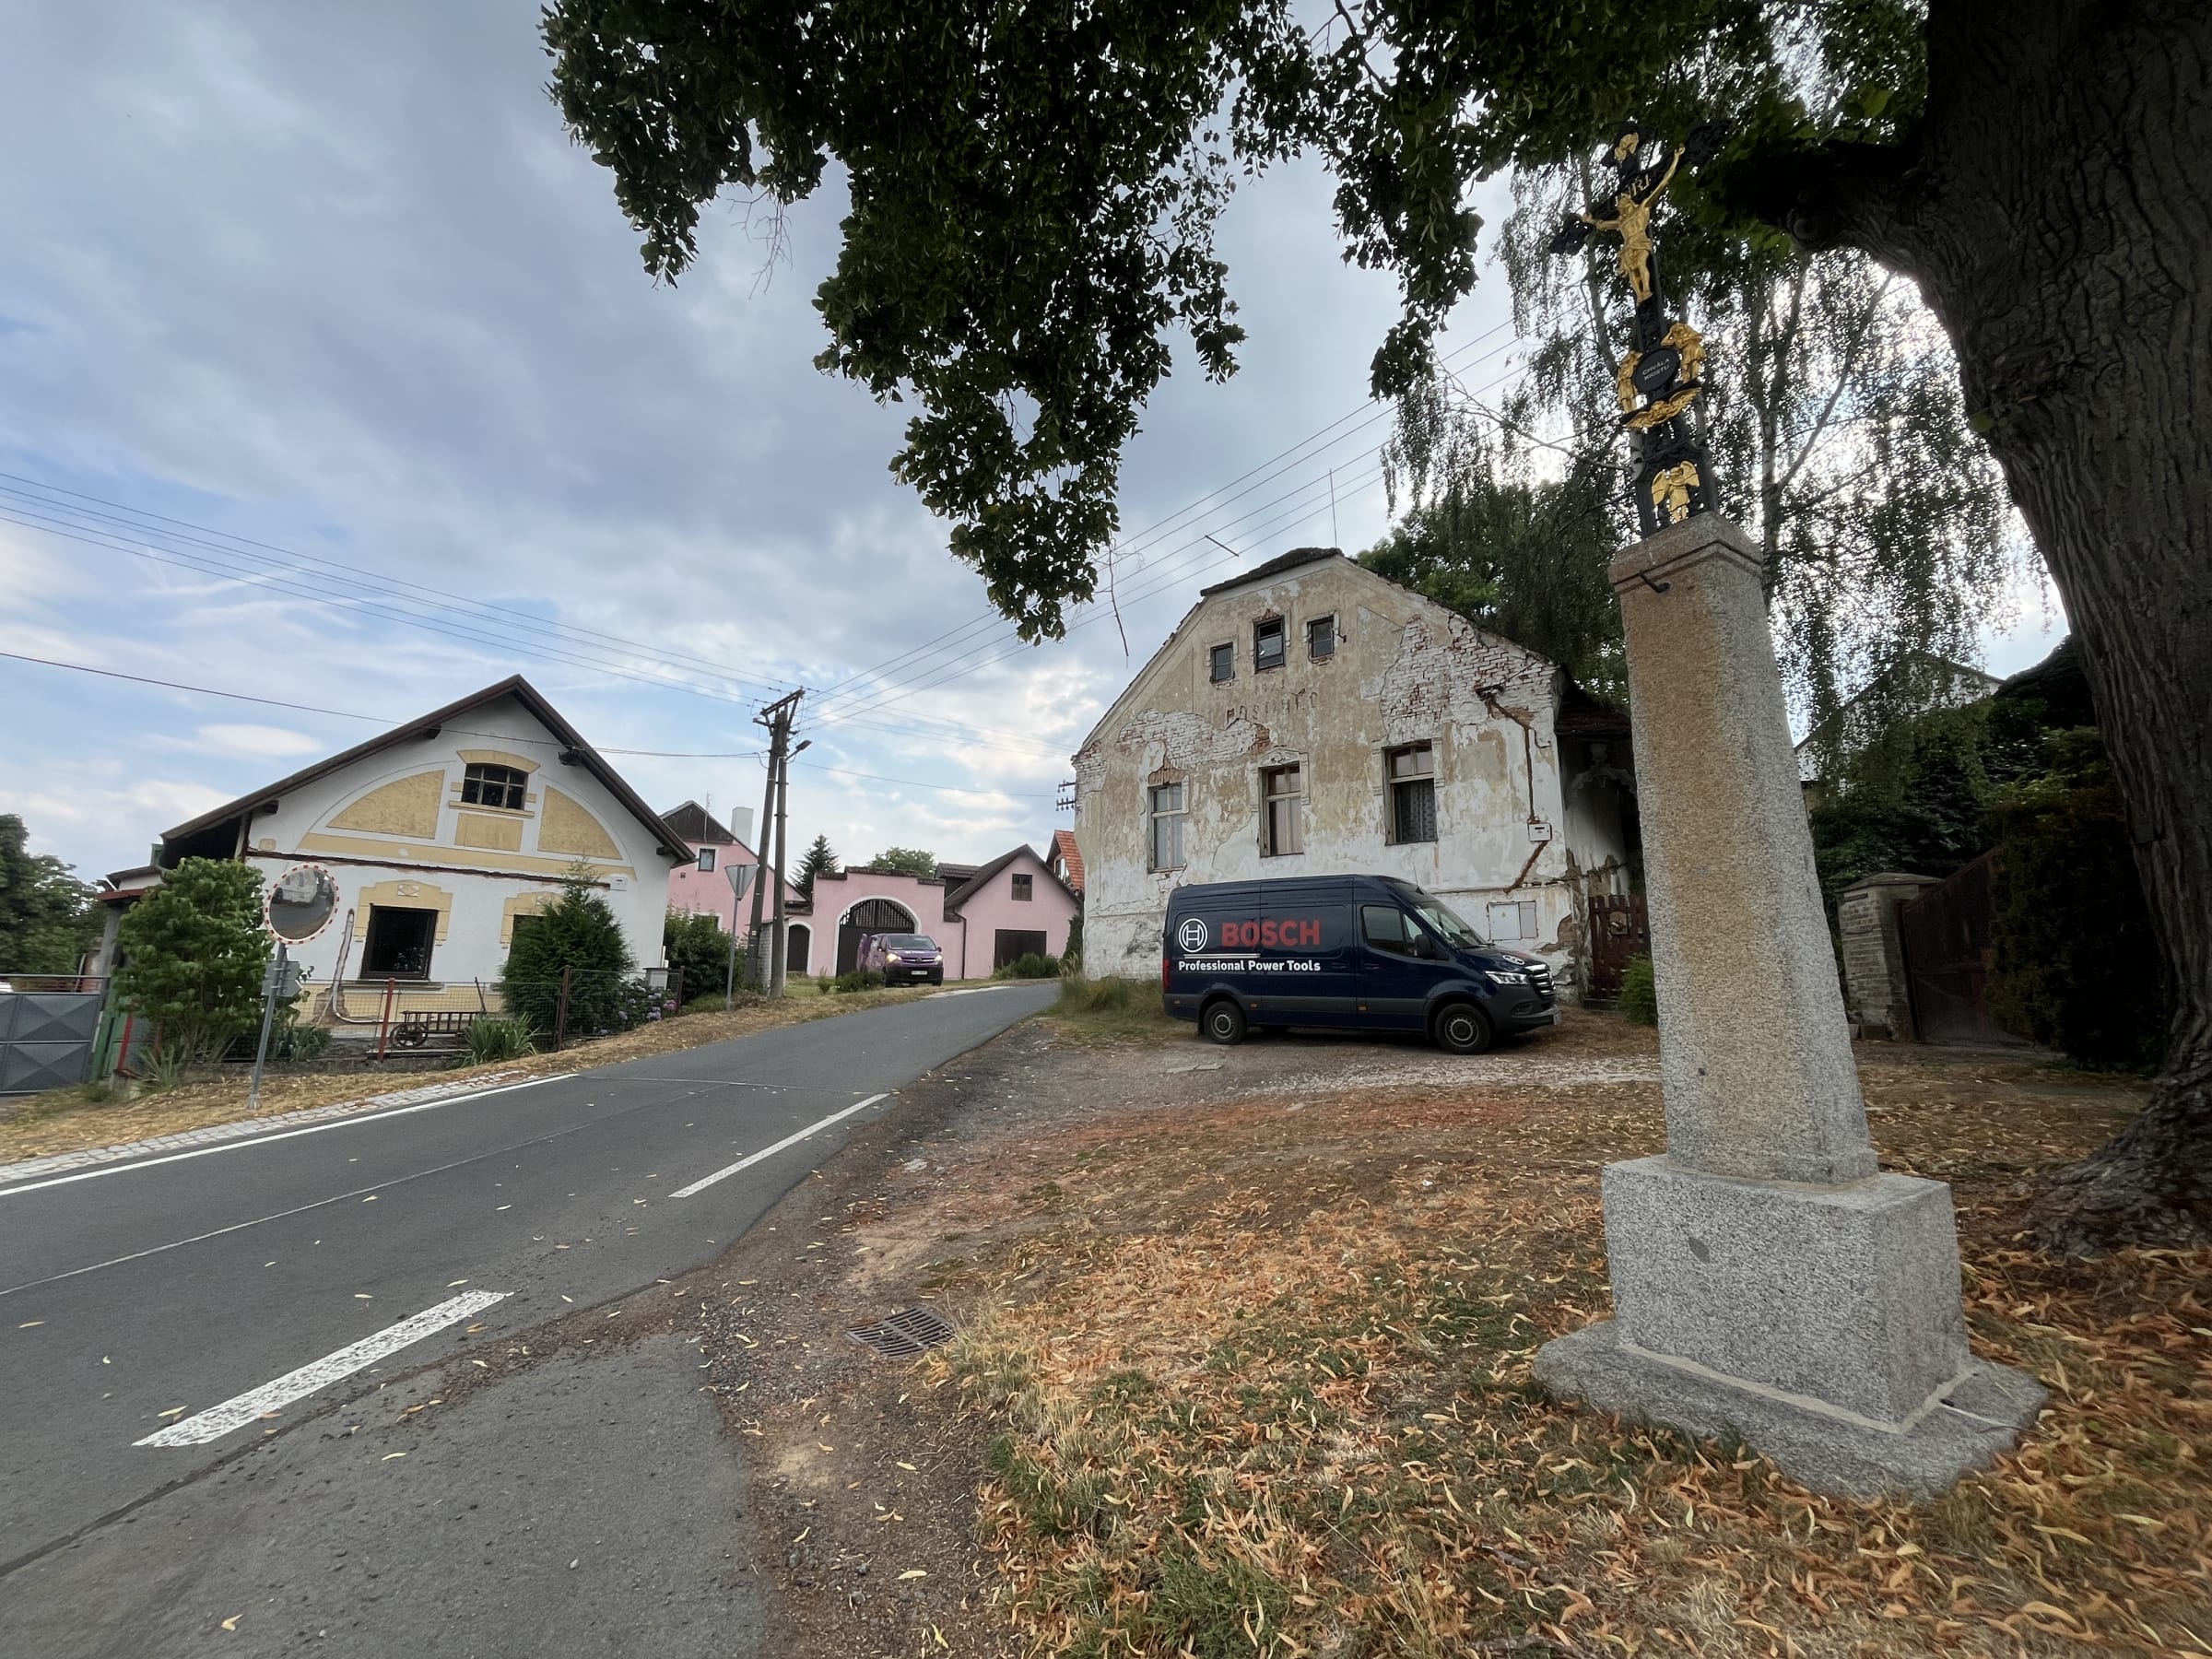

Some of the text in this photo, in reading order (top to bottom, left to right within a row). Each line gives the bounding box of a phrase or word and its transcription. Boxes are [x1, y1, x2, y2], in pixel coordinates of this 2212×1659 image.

[1643, 364, 1669, 381] KRISTU
[1221, 919, 1321, 947] BOSCH
[1178, 959, 1321, 971] Professional Power Tools
